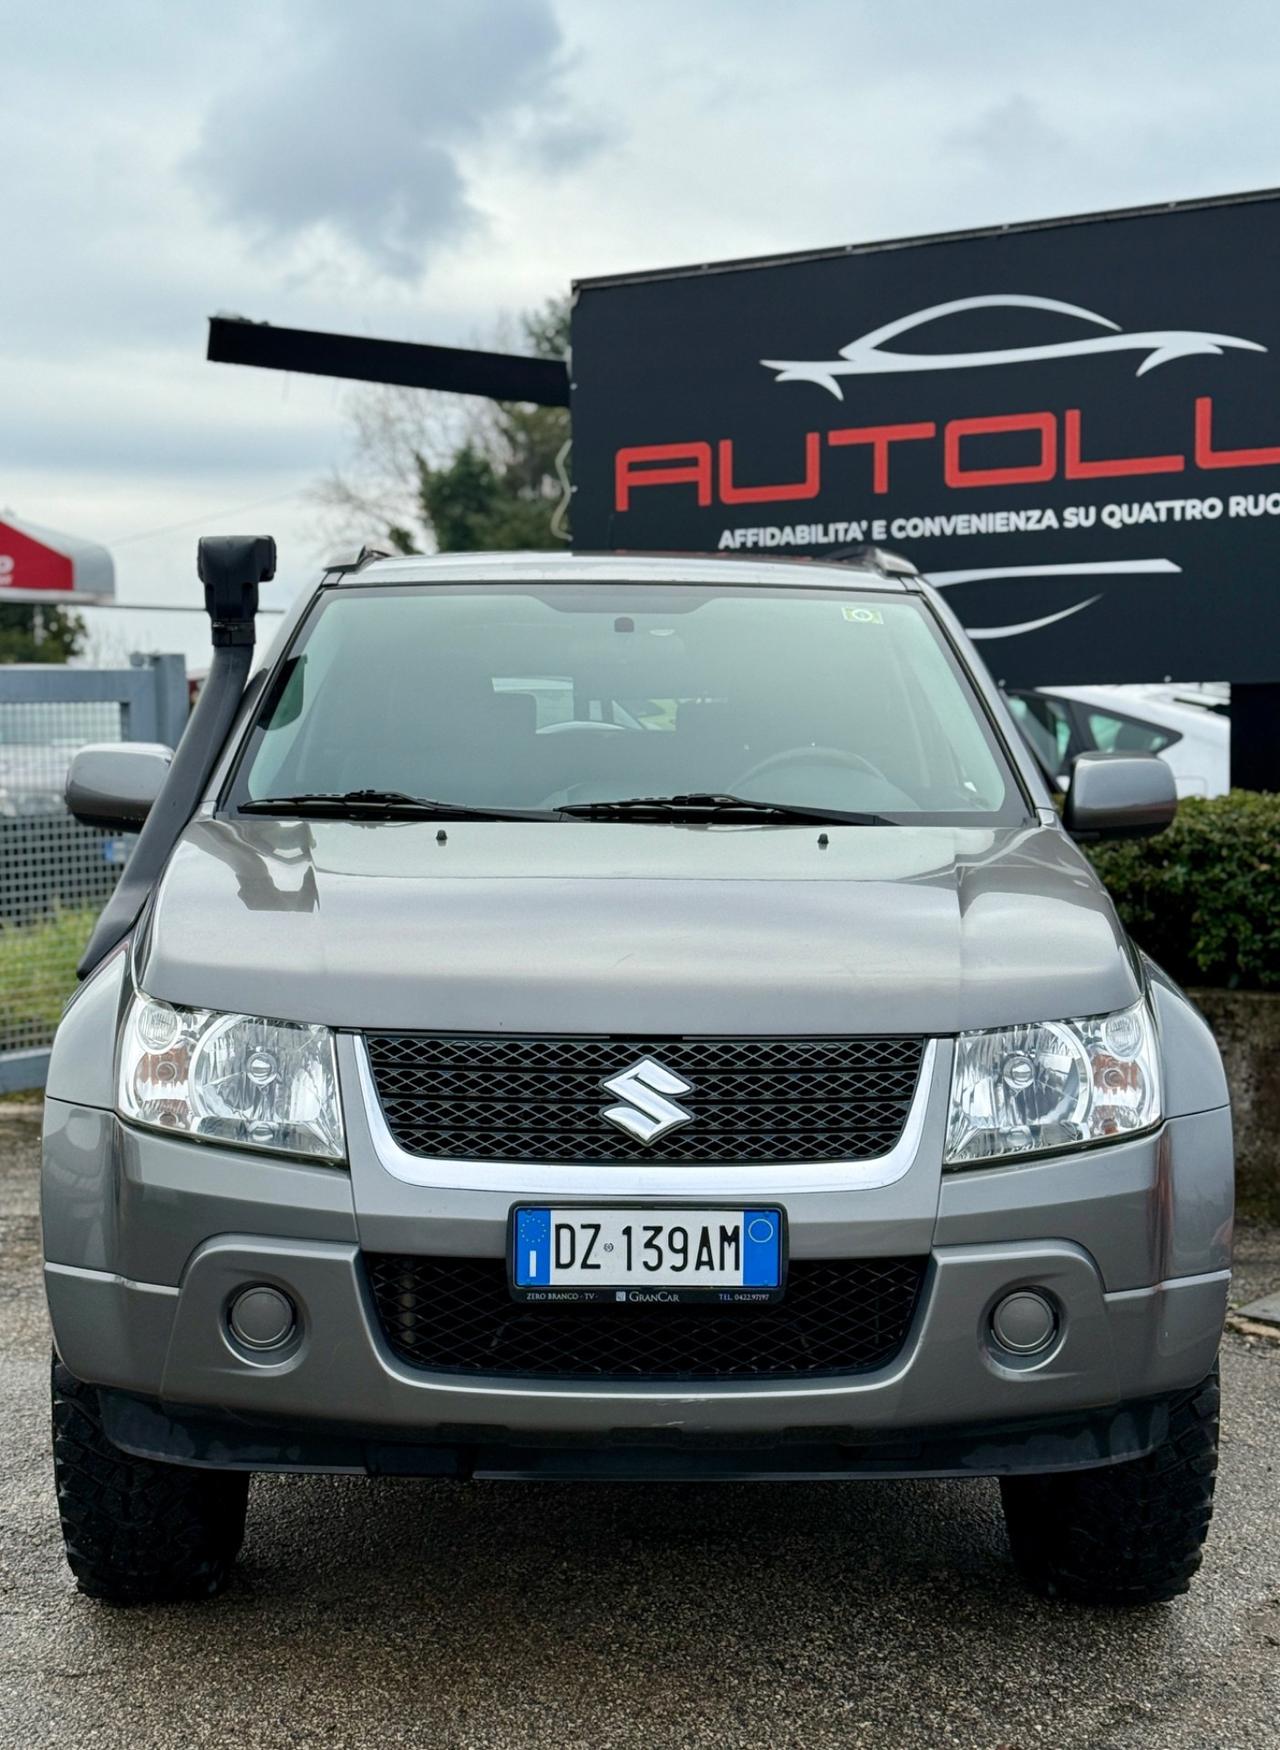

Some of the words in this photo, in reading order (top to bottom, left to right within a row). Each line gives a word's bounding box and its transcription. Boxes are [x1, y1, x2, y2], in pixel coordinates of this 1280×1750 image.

[718, 519, 868, 550] AFFIDABILITA'
[871, 519, 888, 541] E
[890, 508, 1060, 540] CONVENIENZA
[1062, 505, 1097, 529] SU
[1100, 496, 1224, 530] QUATTRO
[526, 1292, 546, 1301] ZERO
